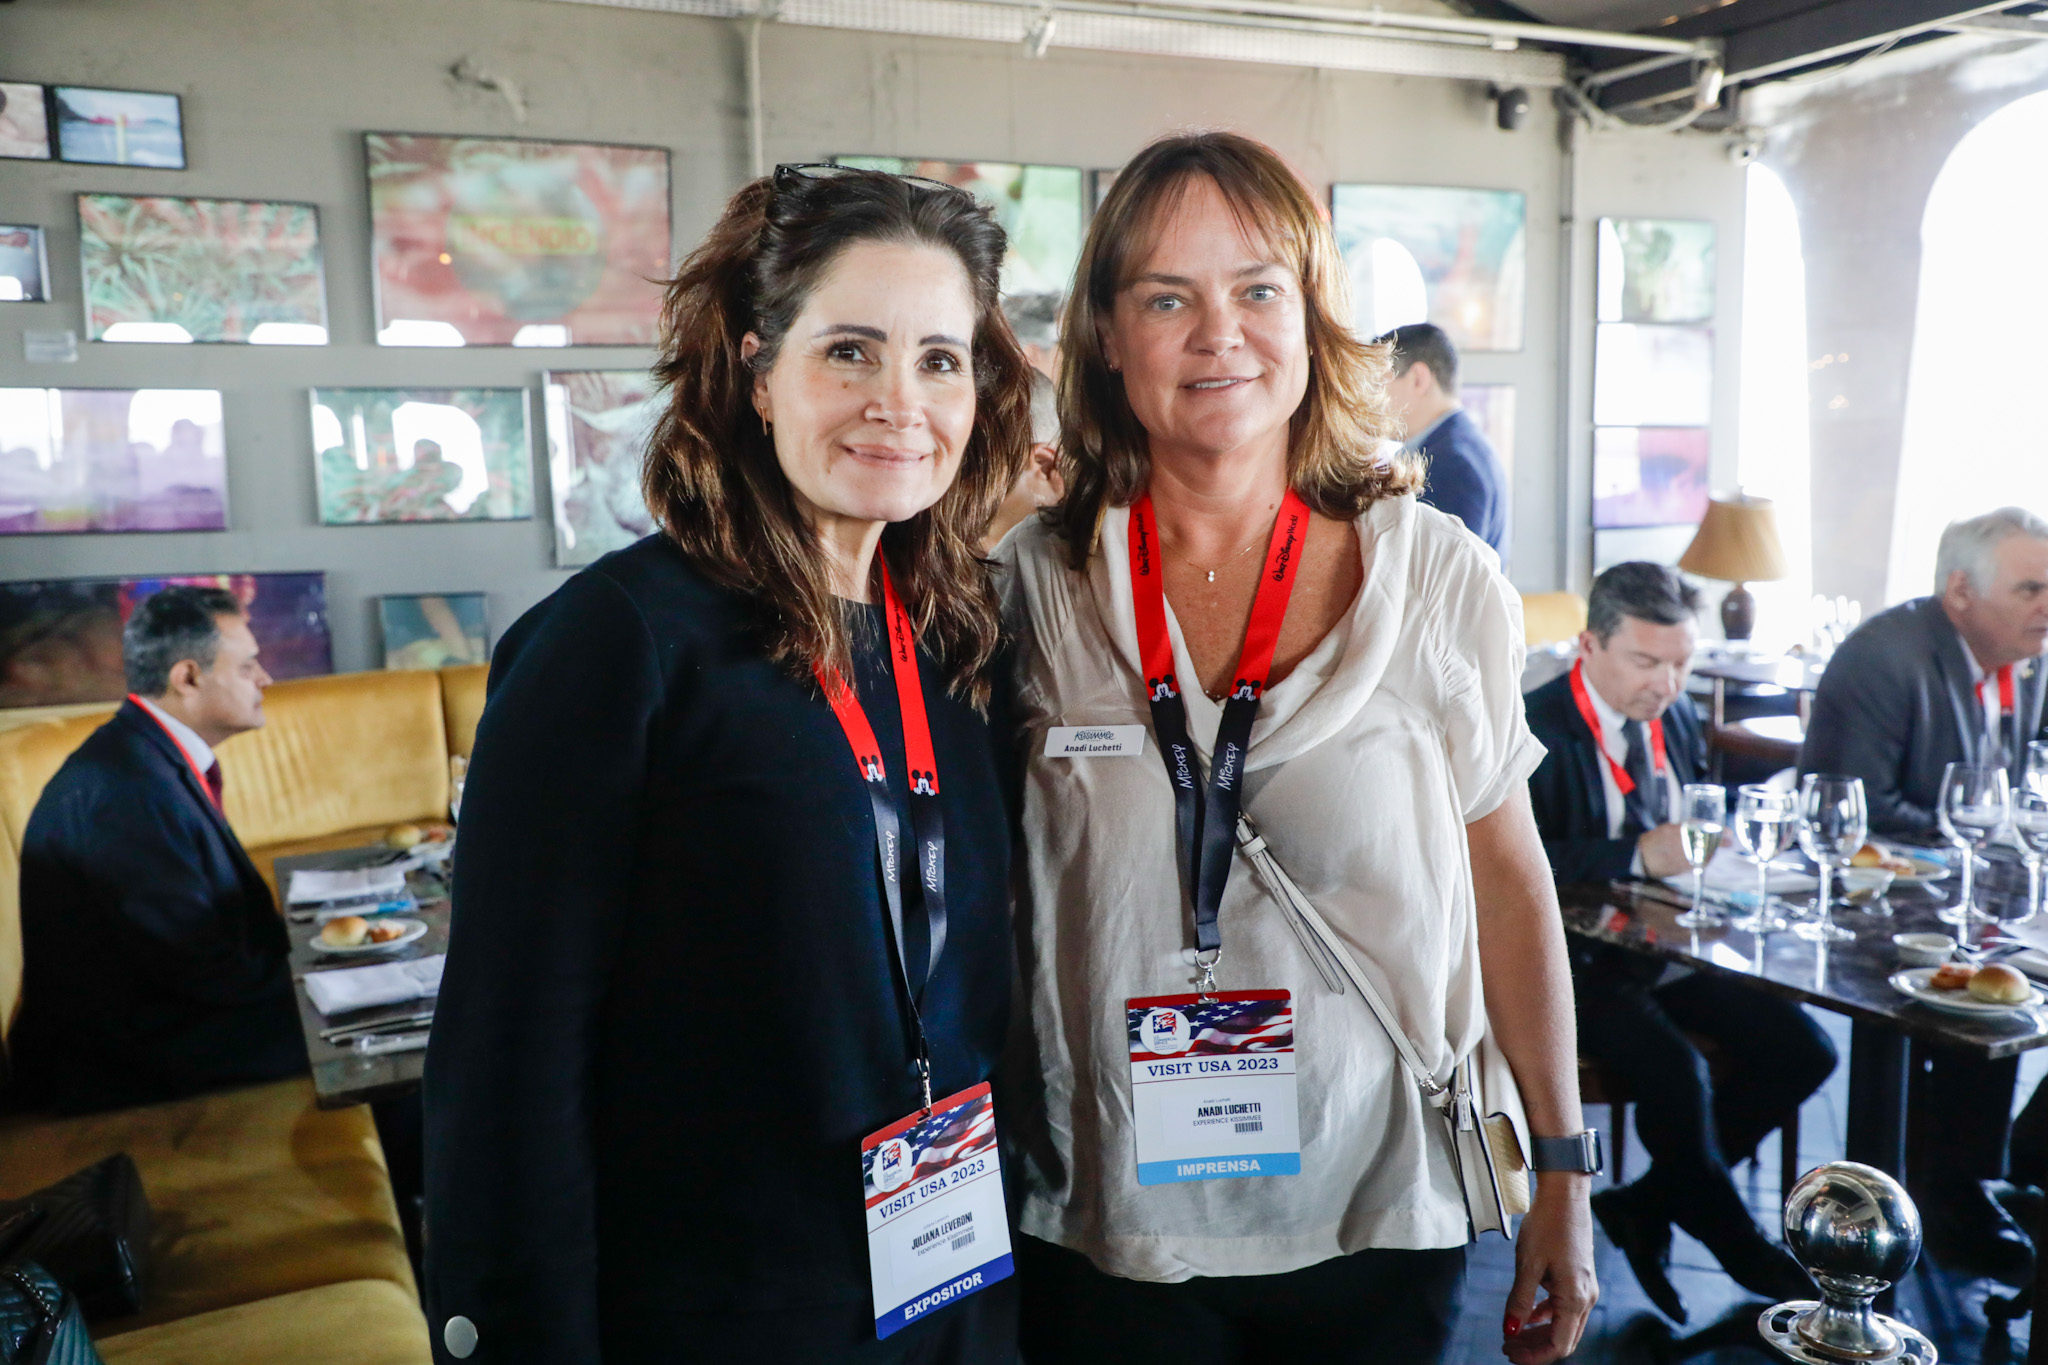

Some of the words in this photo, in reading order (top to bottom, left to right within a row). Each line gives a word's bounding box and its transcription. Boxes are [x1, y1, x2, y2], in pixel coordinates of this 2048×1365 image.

[1064, 744, 1087, 752] Anadi
[1089, 743, 1122, 751] Luchetti
[1148, 1062, 1193, 1077] VISIT
[1198, 1060, 1232, 1073] USA
[1237, 1058, 1279, 1071] 2023
[1198, 1105, 1222, 1117] ANADI
[1224, 1102, 1261, 1115] LUCHETTI
[1193, 1117, 1228, 1126] EXPERIENCE
[1230, 1115, 1262, 1123] KISSIMMEE
[1177, 1159, 1261, 1177] IMPRENSA
[880, 1192, 916, 1219] VISIT
[920, 1177, 947, 1199] USA
[951, 1160, 985, 1184] 2023
[911, 1227, 940, 1250] JULIANA
[941, 1211, 973, 1235] LEVERONI
[904, 1272, 983, 1320] EXPOSITOR
